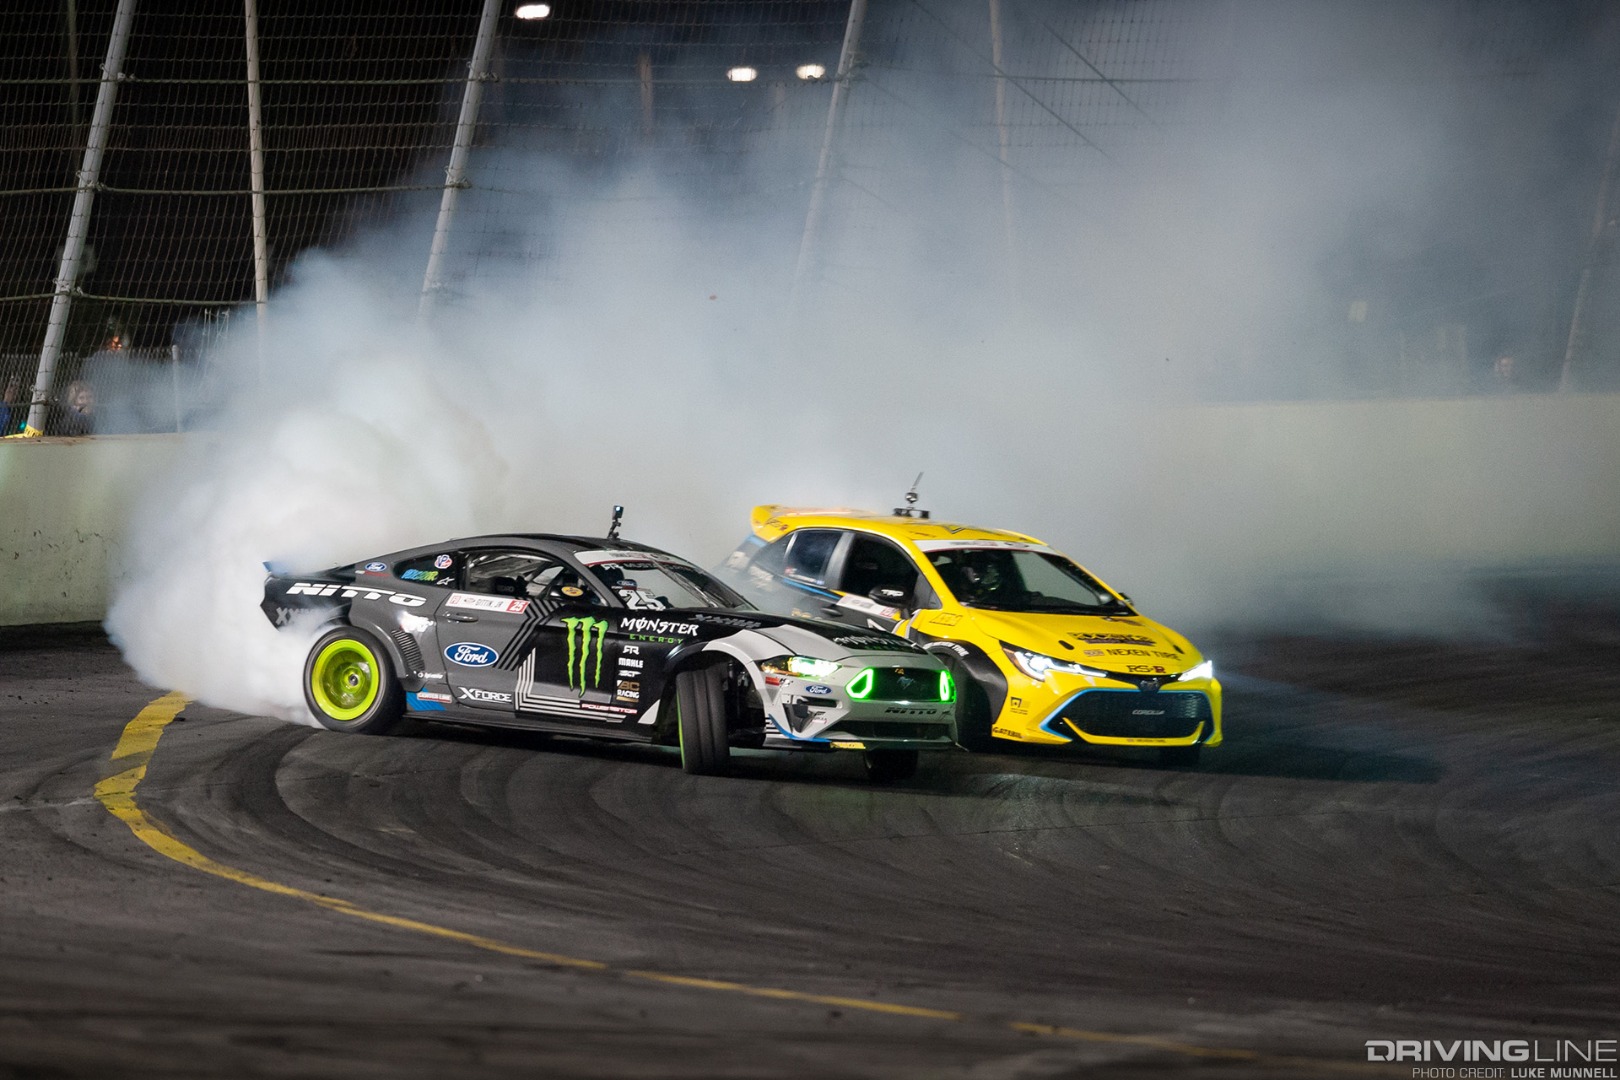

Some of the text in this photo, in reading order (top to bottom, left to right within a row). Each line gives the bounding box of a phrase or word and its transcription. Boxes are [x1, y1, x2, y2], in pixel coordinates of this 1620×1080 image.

[286, 582, 427, 607] NITTO
[619, 589, 666, 611] 25
[509, 601, 526, 611] 25
[629, 633, 684, 644] ENERGY
[454, 644, 489, 664] Ford
[1106, 648, 1151, 657] NEXEN
[618, 657, 643, 669] MAHLE
[458, 686, 513, 702] XFORCE
[617, 689, 640, 699] RACING
[809, 686, 829, 694] Ford
[885, 706, 938, 715] NITTO
